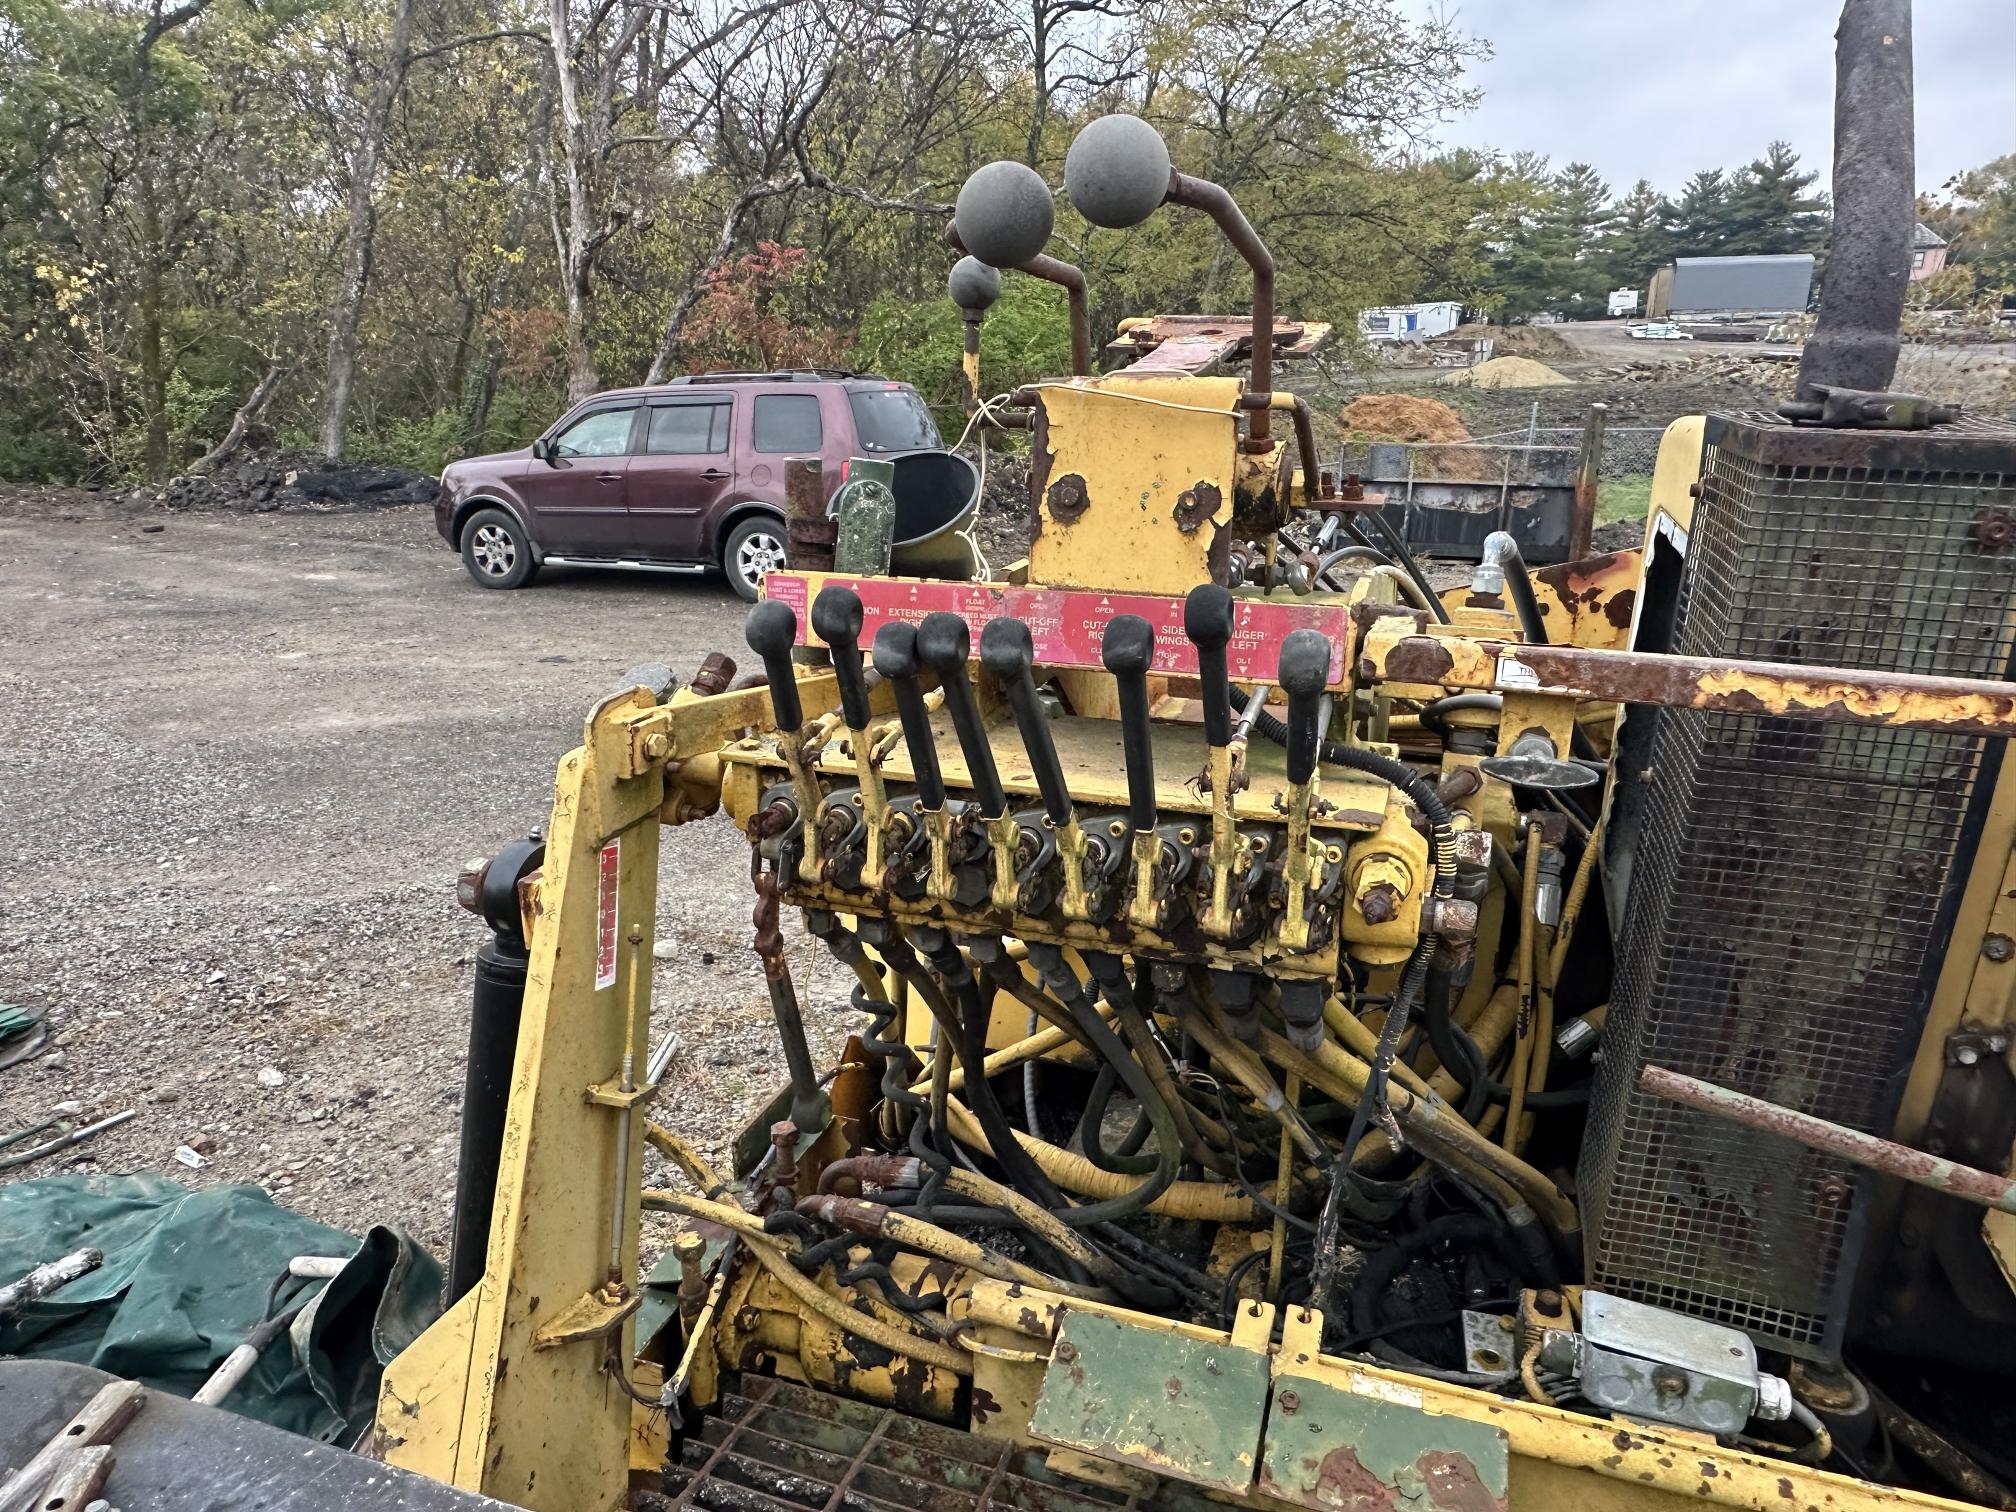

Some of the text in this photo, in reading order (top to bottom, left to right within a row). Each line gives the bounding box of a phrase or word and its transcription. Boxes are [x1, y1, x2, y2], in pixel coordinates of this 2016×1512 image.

[1094, 606, 1114, 614] OPEN
[1082, 620, 1108, 630] CUT-
[1161, 625, 1185, 635] SIDE
[1031, 626, 1049, 636] EFT
[1088, 630, 1104, 640] RIG
[1155, 635, 1190, 646] WINGS
[1232, 640, 1259, 650] LEFT
